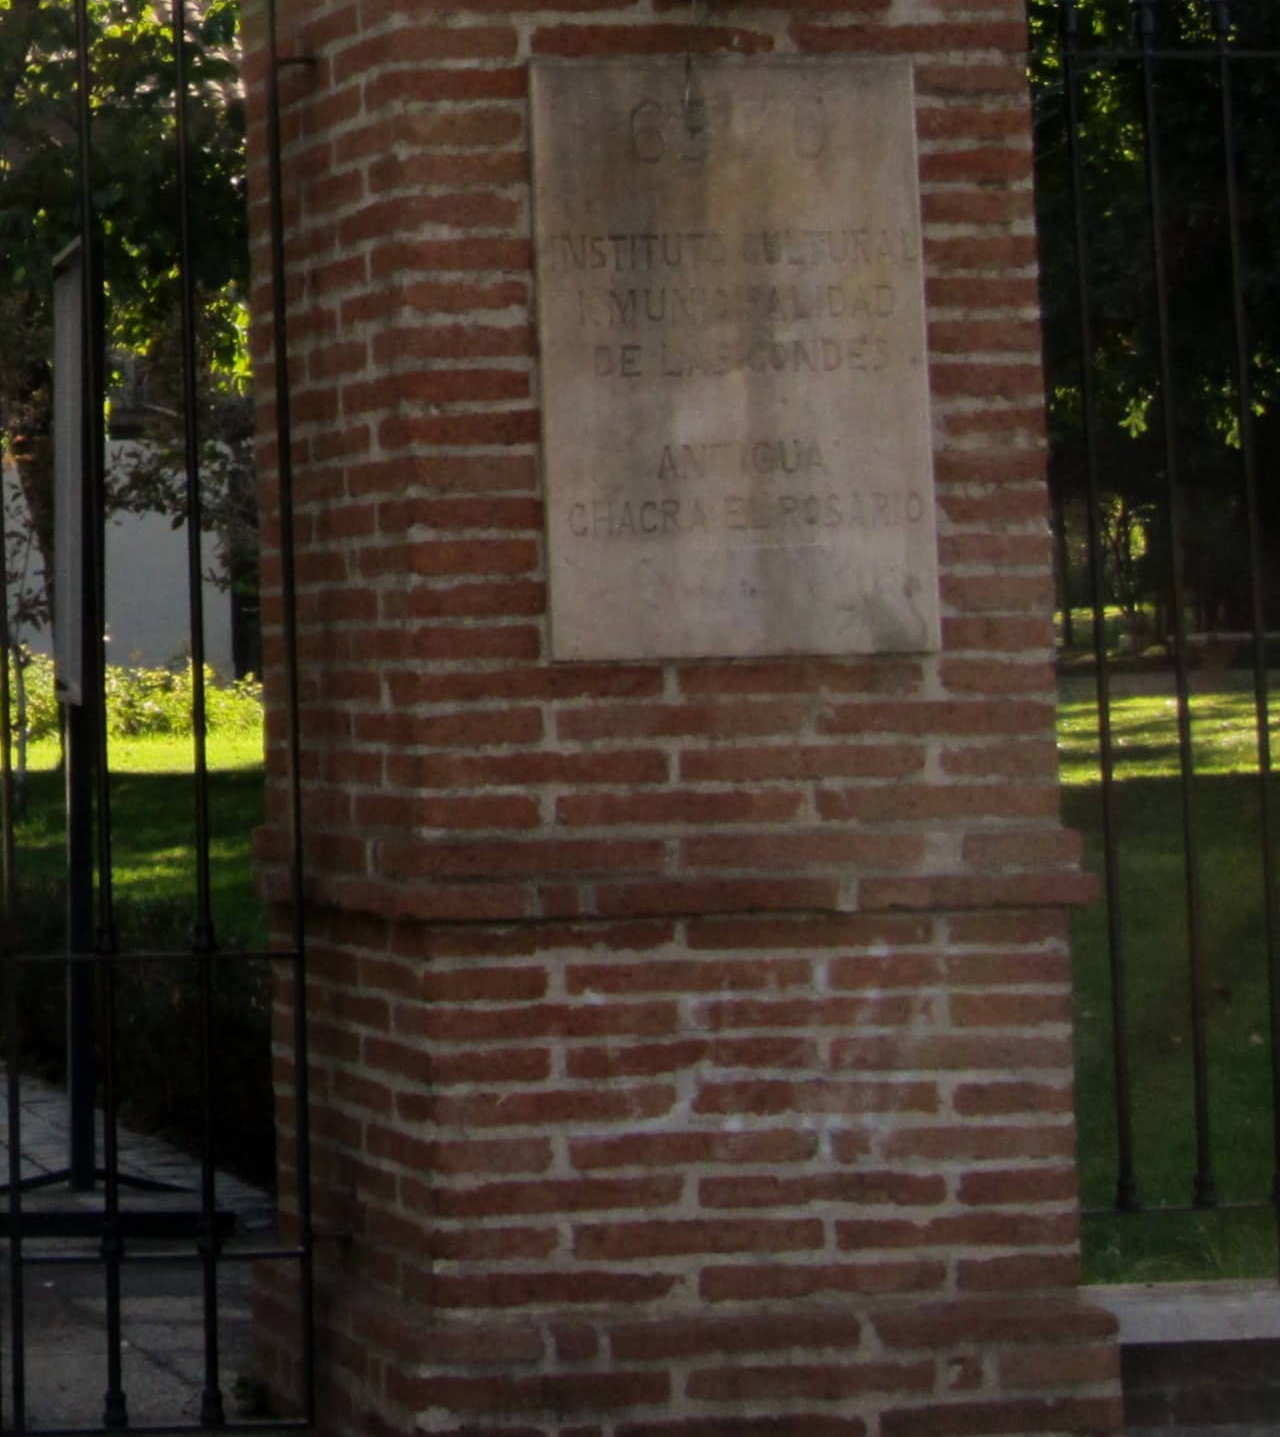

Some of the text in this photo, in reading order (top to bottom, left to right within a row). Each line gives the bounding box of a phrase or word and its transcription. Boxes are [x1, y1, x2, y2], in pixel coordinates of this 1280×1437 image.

[550, 228, 919, 272] INSTITUTO CULTURAL
[593, 337, 890, 378] DE LAS CONDES
[657, 438, 828, 481] ANTIGUA
[568, 491, 925, 539] CHACRA EL ROSARIO
